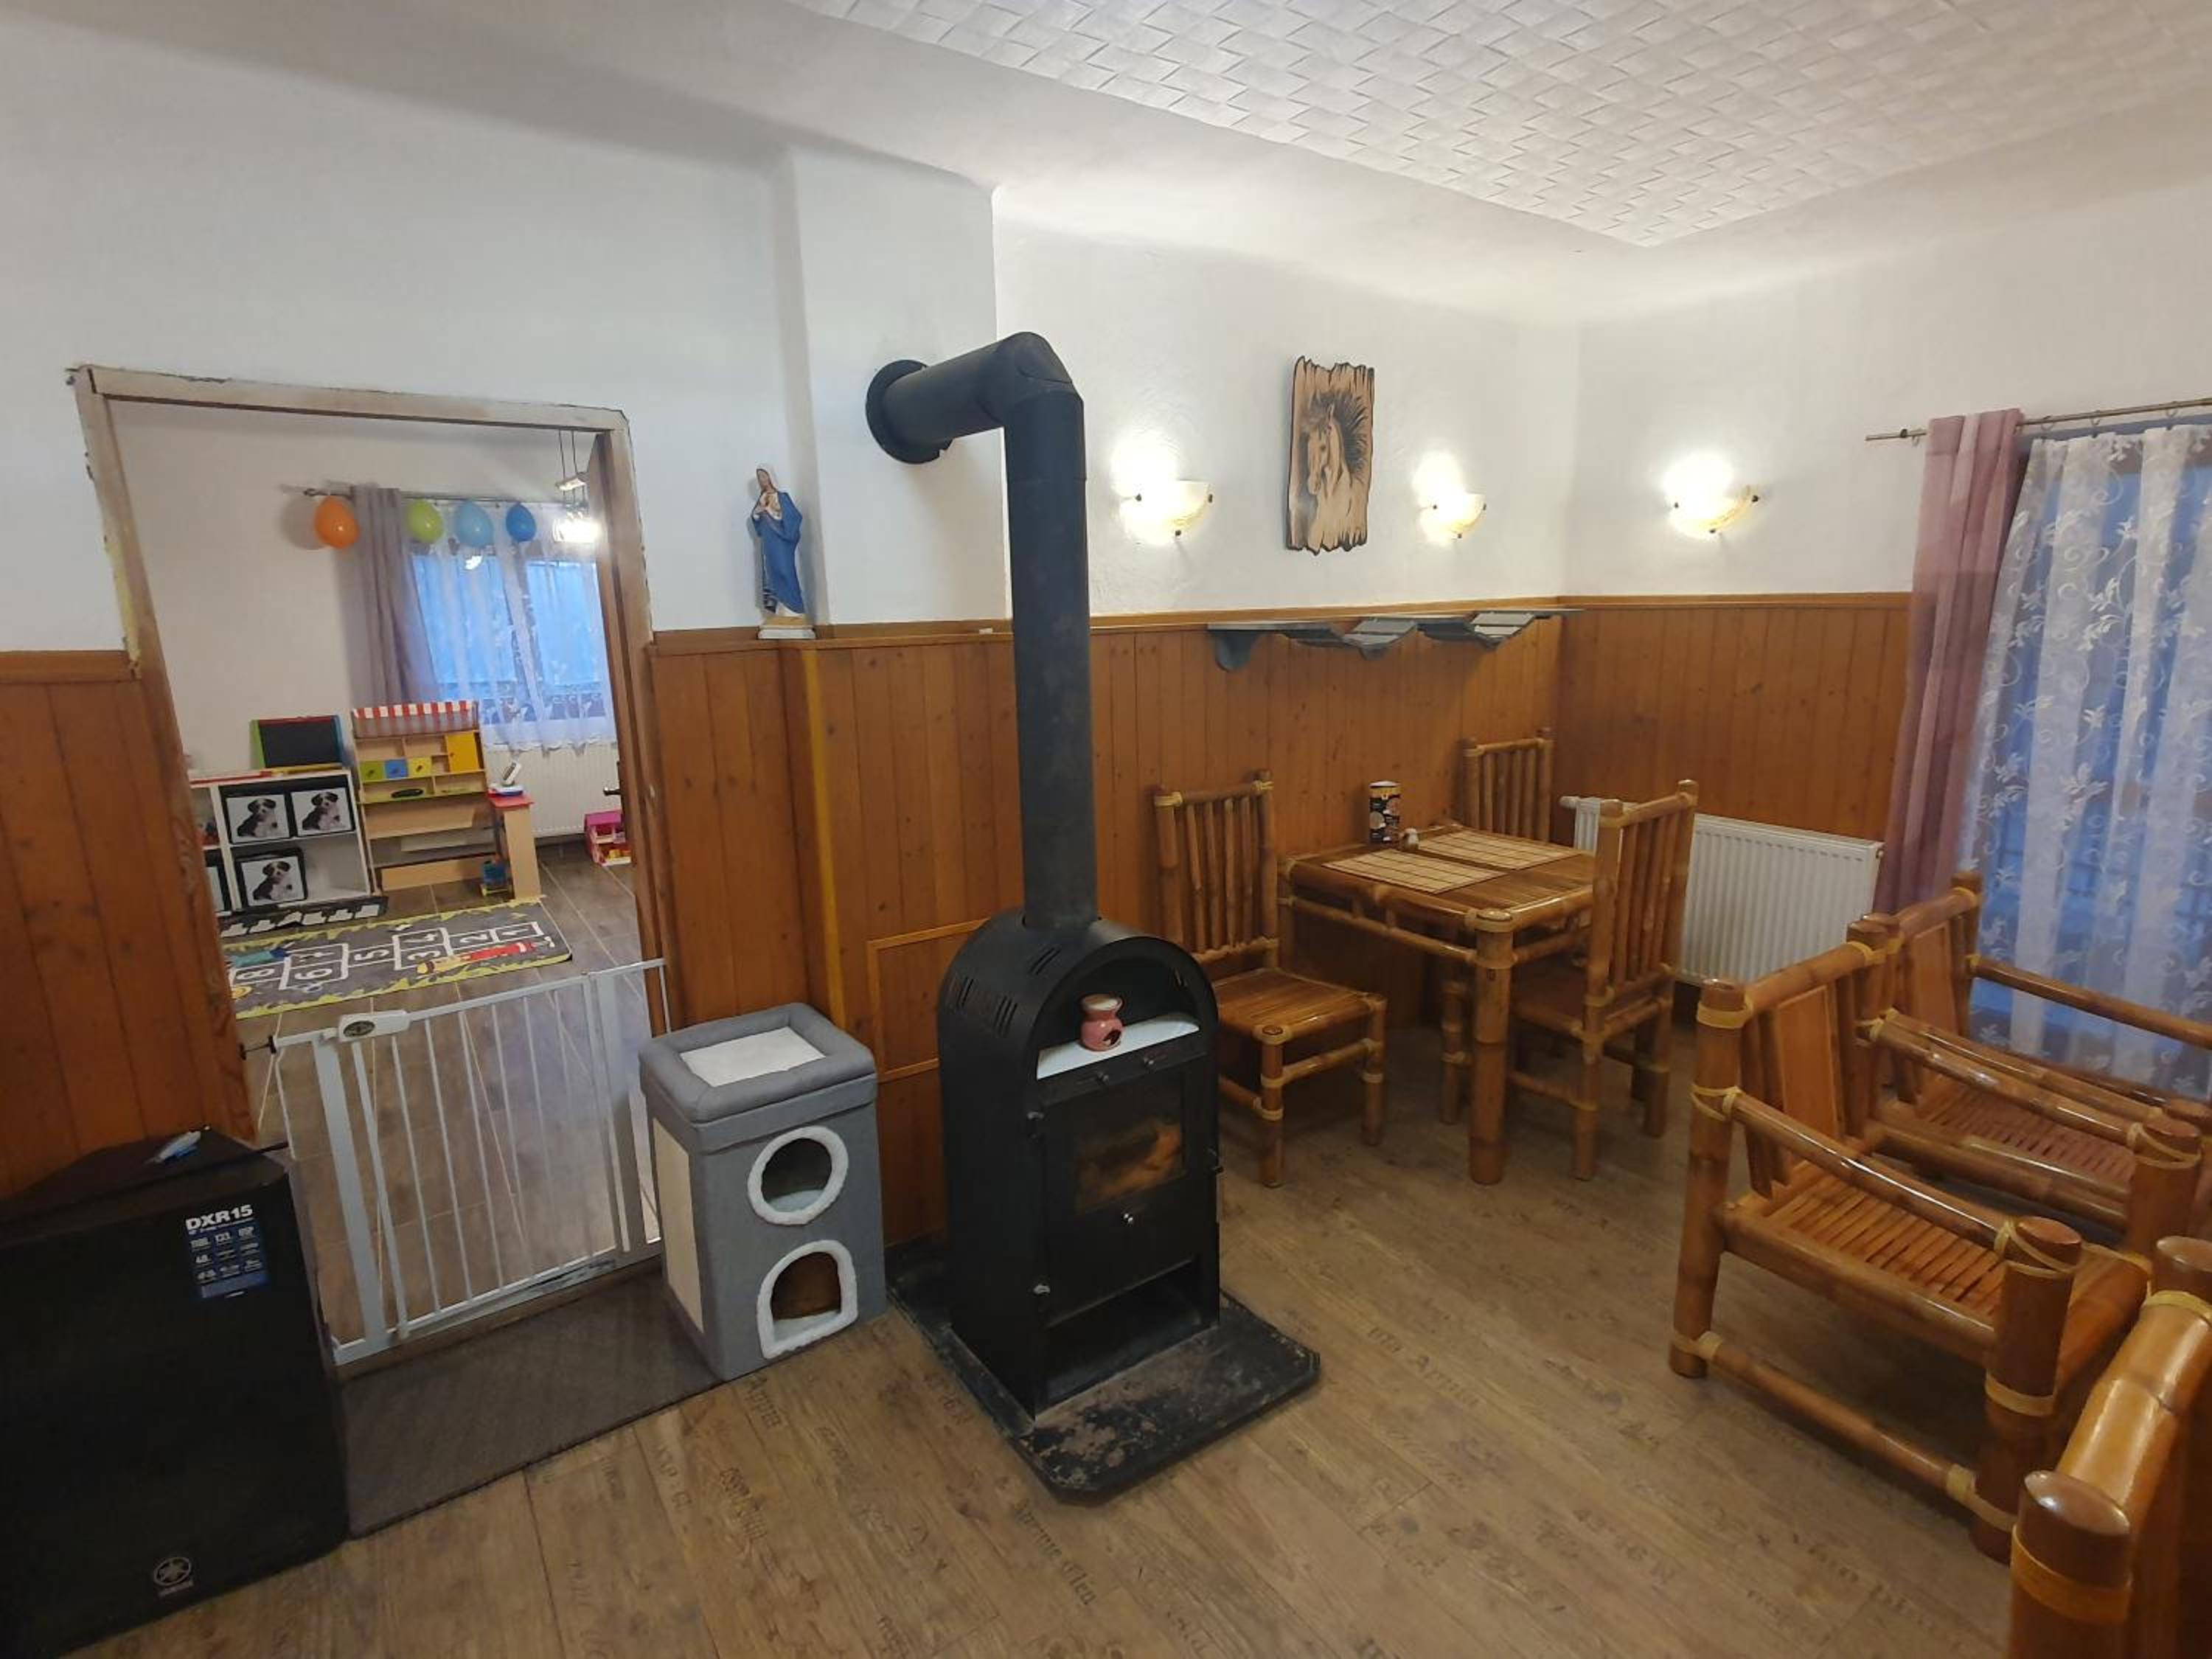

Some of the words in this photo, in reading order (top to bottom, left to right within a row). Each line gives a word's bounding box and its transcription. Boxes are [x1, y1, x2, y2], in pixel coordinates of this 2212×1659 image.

[403, 933, 439, 944] 4
[459, 933, 489, 944] 2
[353, 949, 389, 961] 5
[408, 950, 441, 961] 3
[236, 967, 275, 980] 8
[295, 967, 333, 980] 6
[186, 1205, 253, 1230] DXR15
